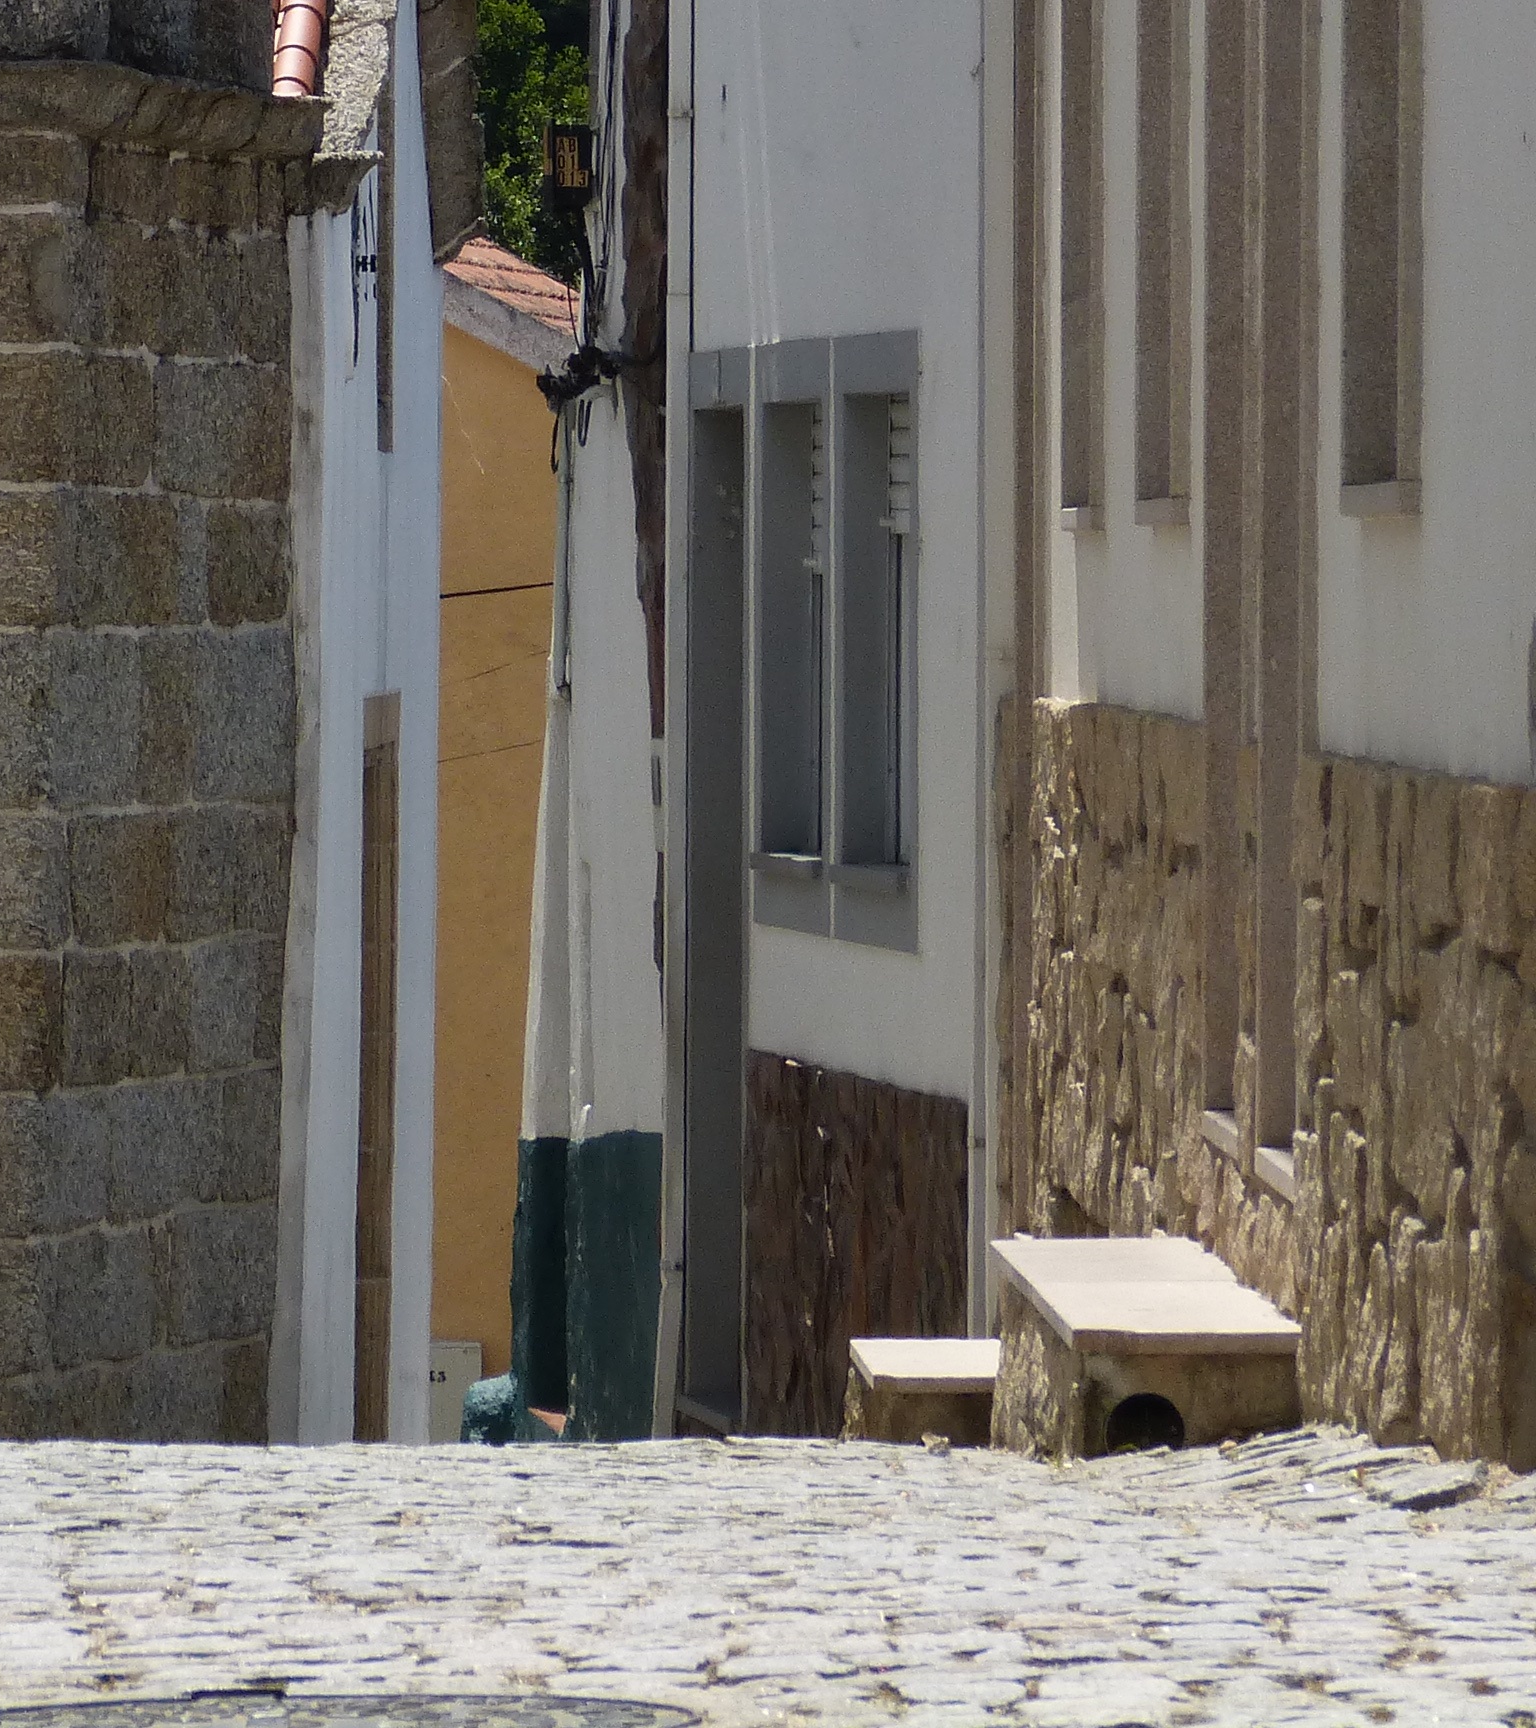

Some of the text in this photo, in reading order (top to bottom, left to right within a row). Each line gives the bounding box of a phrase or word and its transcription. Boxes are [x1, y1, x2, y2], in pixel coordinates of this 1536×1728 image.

[557, 138, 576, 153] AB
[557, 154, 575, 169] 01
[557, 170, 586, 186] 013
